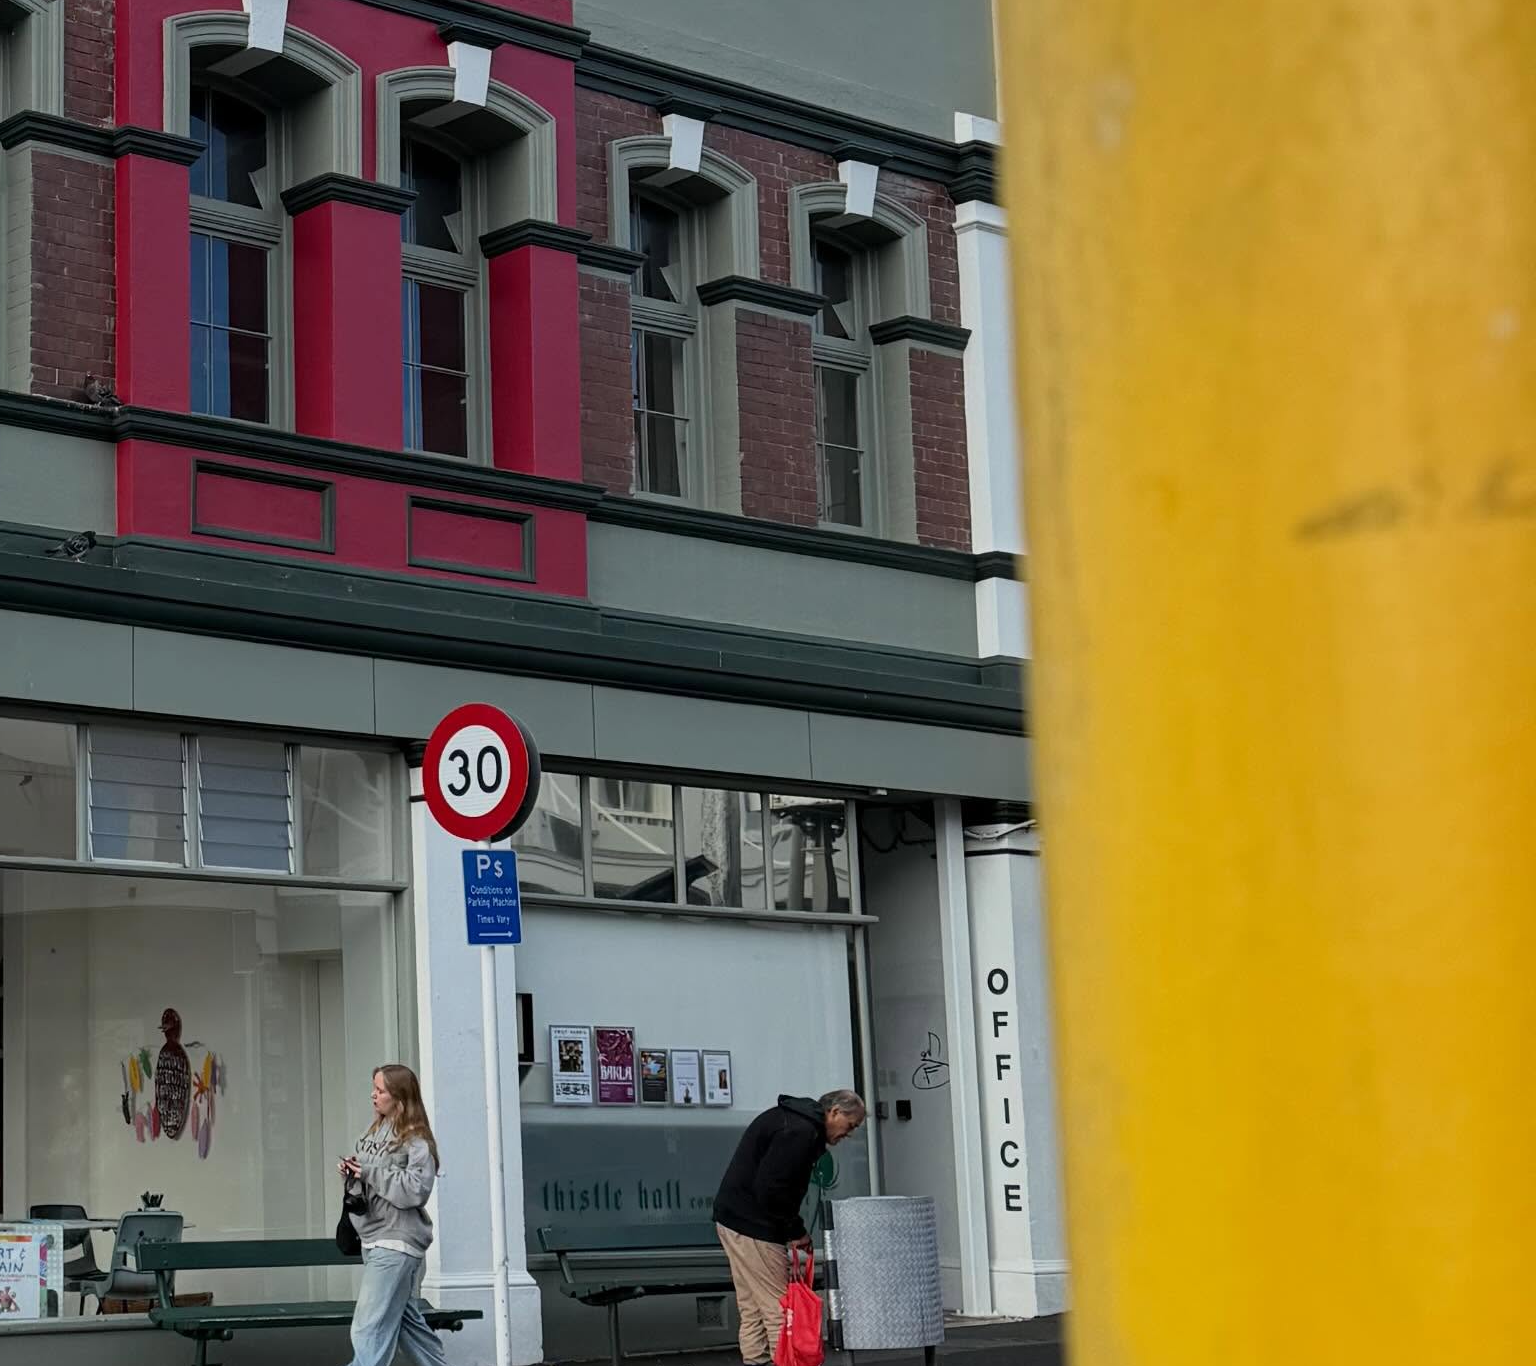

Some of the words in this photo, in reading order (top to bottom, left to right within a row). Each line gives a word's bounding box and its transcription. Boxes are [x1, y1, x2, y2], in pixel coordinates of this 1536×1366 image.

[447, 745, 502, 796] 30
[470, 884, 503, 895] Conditions
[505, 887, 513, 895] on
[468, 896, 491, 909] Parking
[477, 914, 495, 924] Times
[496, 915, 510, 926] Vary
[986, 967, 1023, 1213] OFFICE
[542, 1179, 623, 1215] thistle
[637, 1178, 681, 1211] hall
